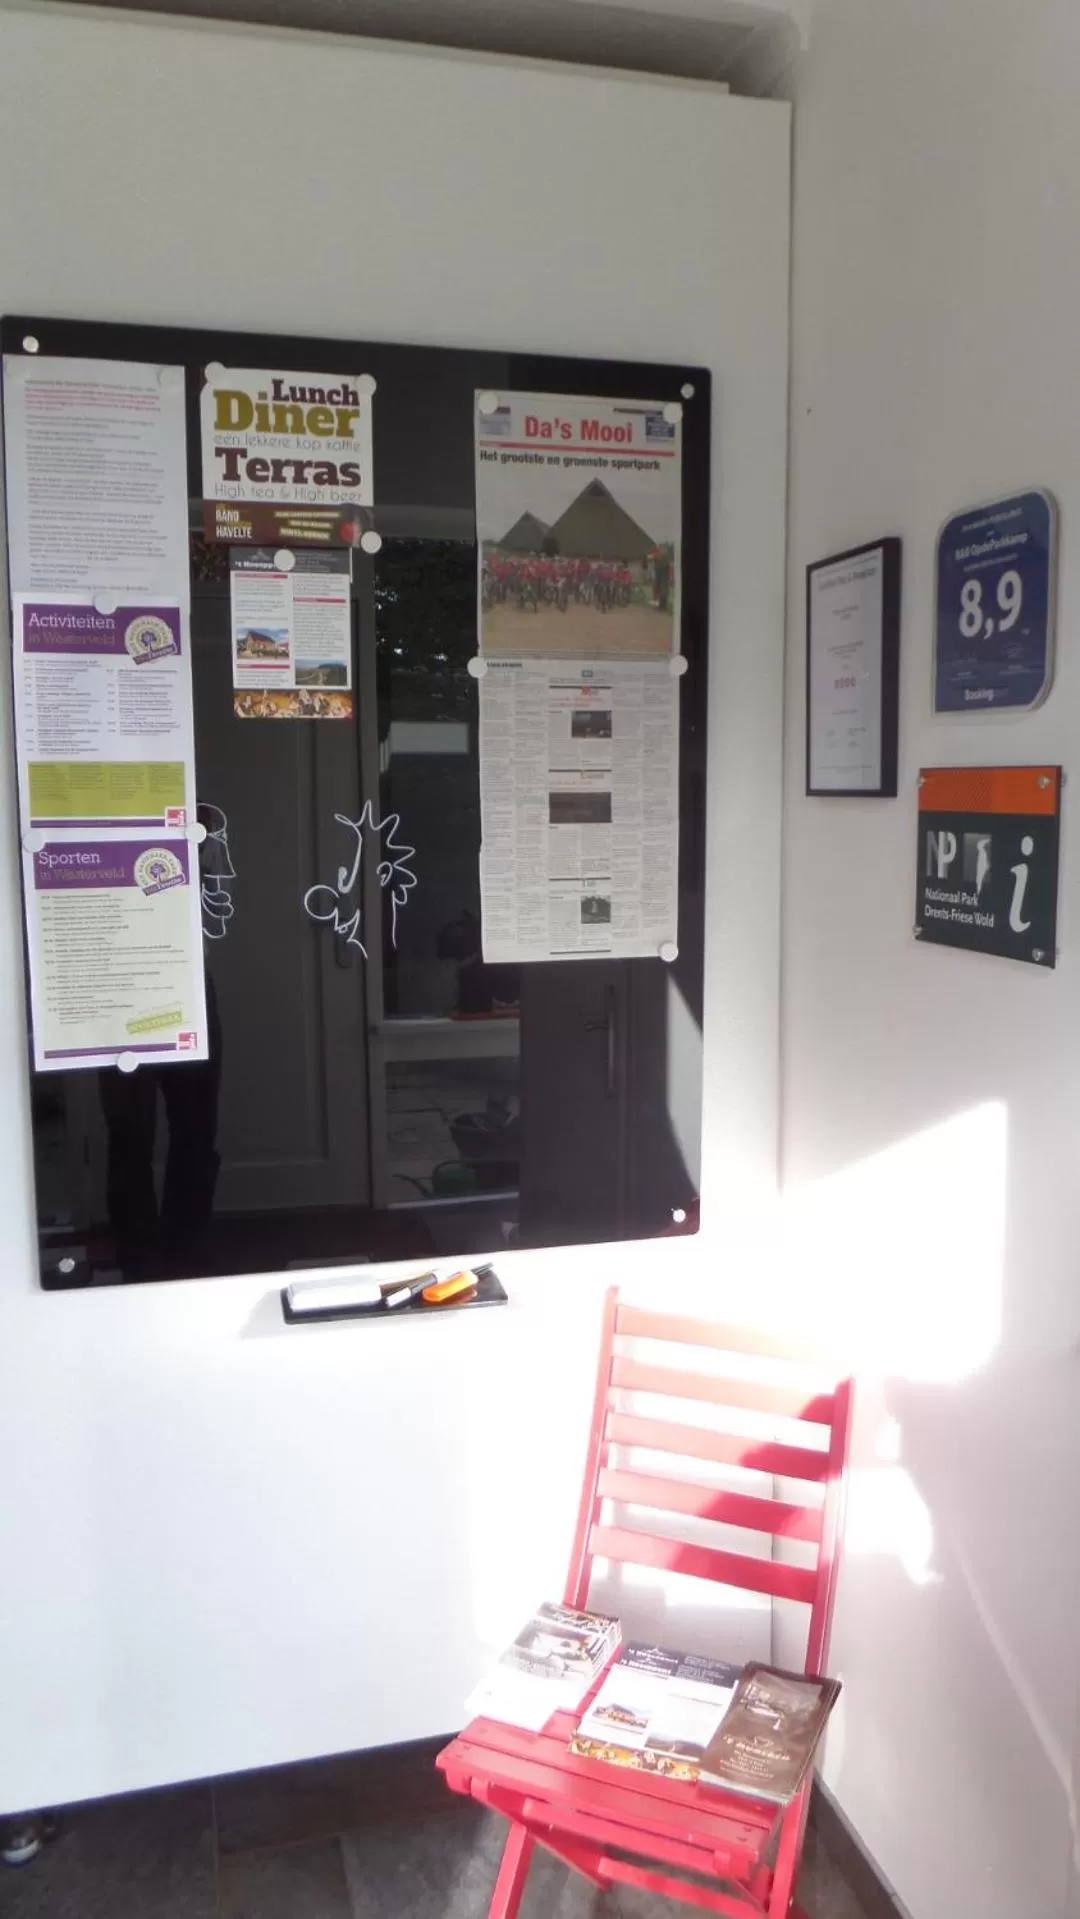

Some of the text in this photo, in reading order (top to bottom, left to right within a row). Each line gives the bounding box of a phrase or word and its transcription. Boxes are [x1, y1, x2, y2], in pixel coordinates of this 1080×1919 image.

[272, 378, 360, 406] Lunch
[213, 389, 360, 438] Diner
[524, 415, 633, 443] Da's Mooi
[215, 446, 361, 488] Terras
[480, 450, 661, 473] Het grootste en groenste sportpark
[214, 483, 246, 499] High
[251, 486, 275, 499] tea
[294, 486, 327, 501] High
[330, 488, 362, 502] beer
[215, 525, 252, 539] HAVELTE
[959, 569, 1023, 640] 8,9
[28, 612, 115, 629] Activiteiten
[39, 851, 101, 868] Sporten
[925, 887, 978, 907] Nationaal Park
[924, 904, 995, 928] Drents-Friese Wold
